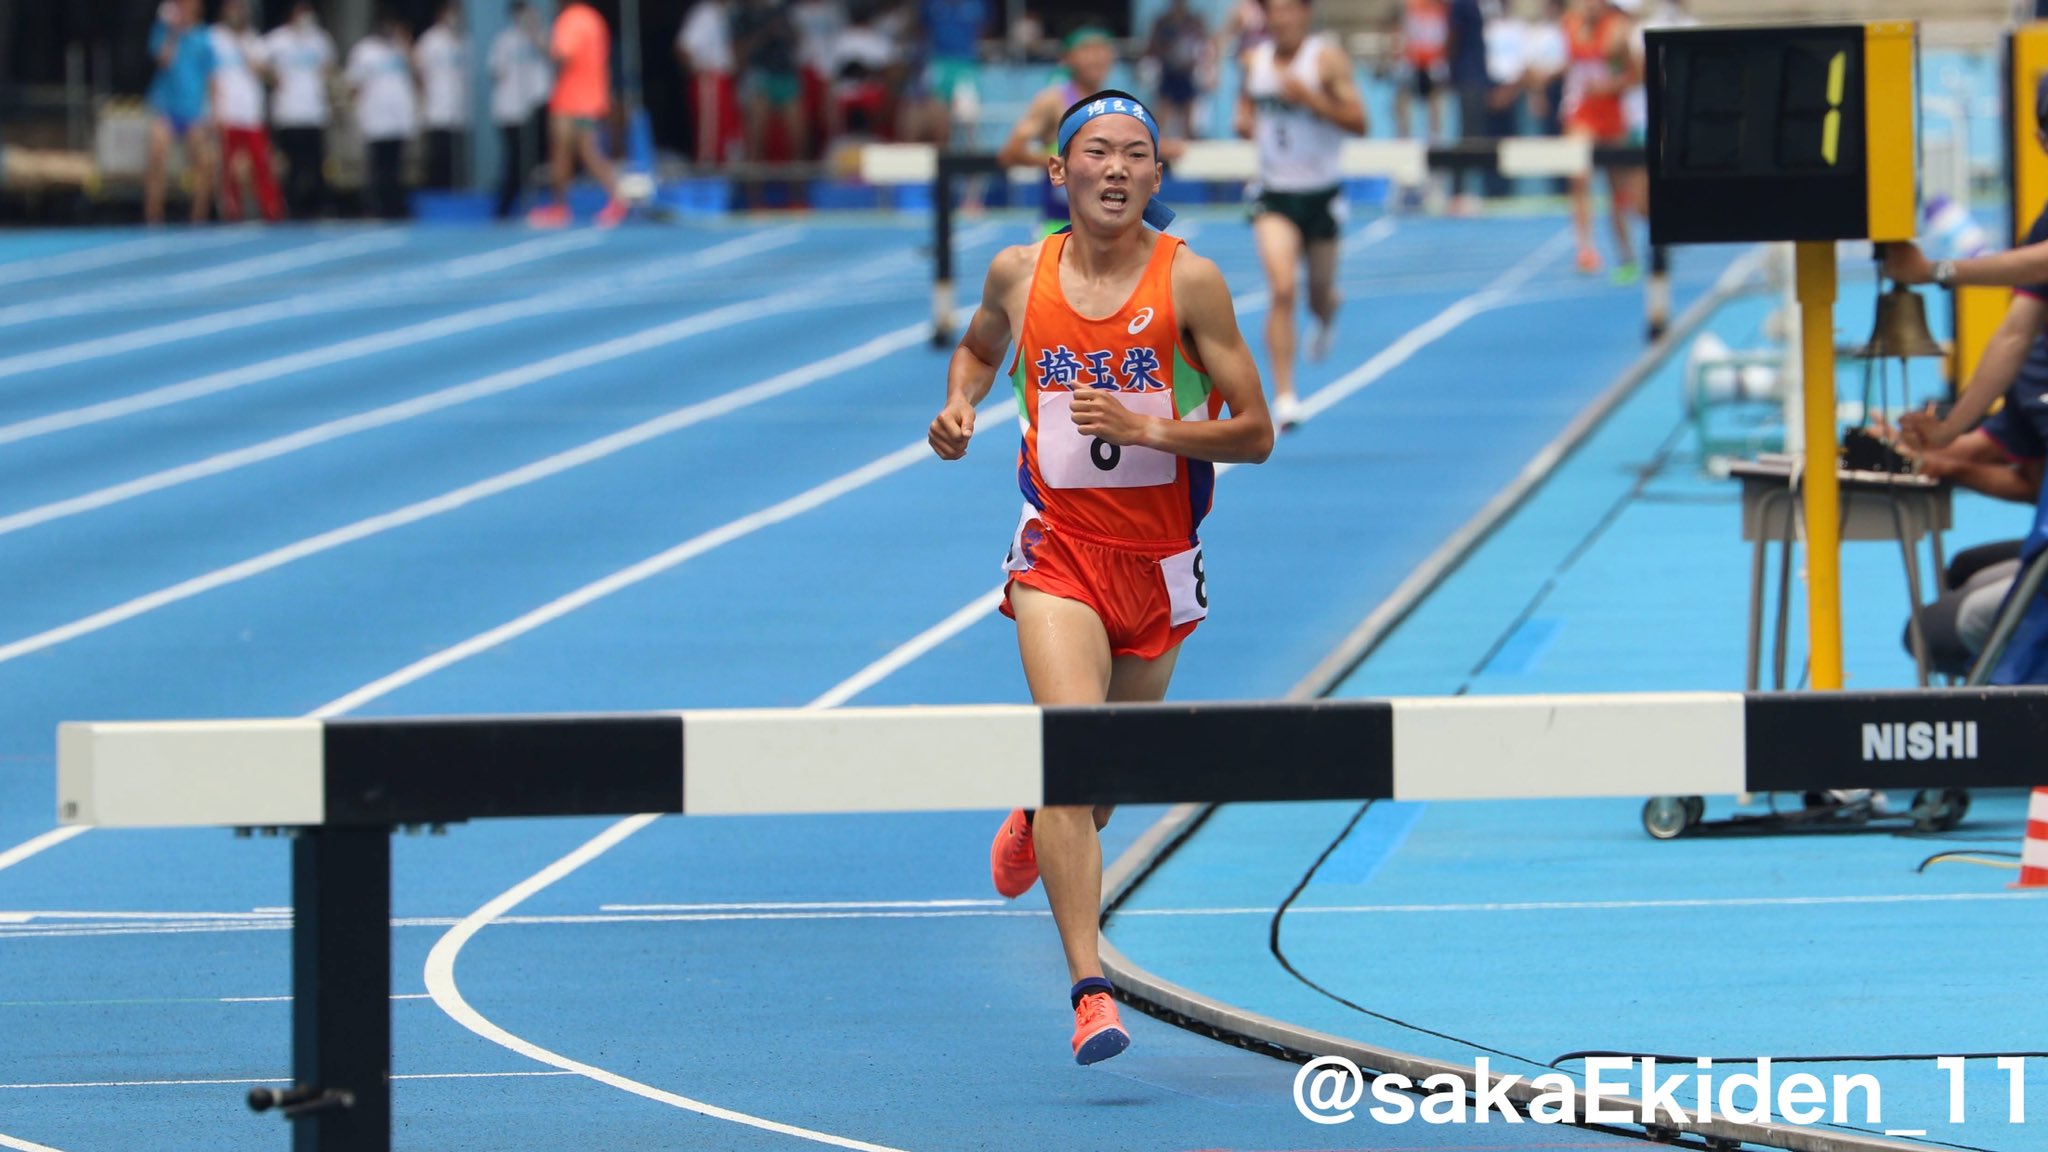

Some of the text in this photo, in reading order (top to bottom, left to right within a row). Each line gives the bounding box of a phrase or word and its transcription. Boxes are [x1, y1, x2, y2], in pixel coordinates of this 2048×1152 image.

[1035, 344, 1166, 393] 埼玉栄
[1862, 721, 1978, 761] NISHI
